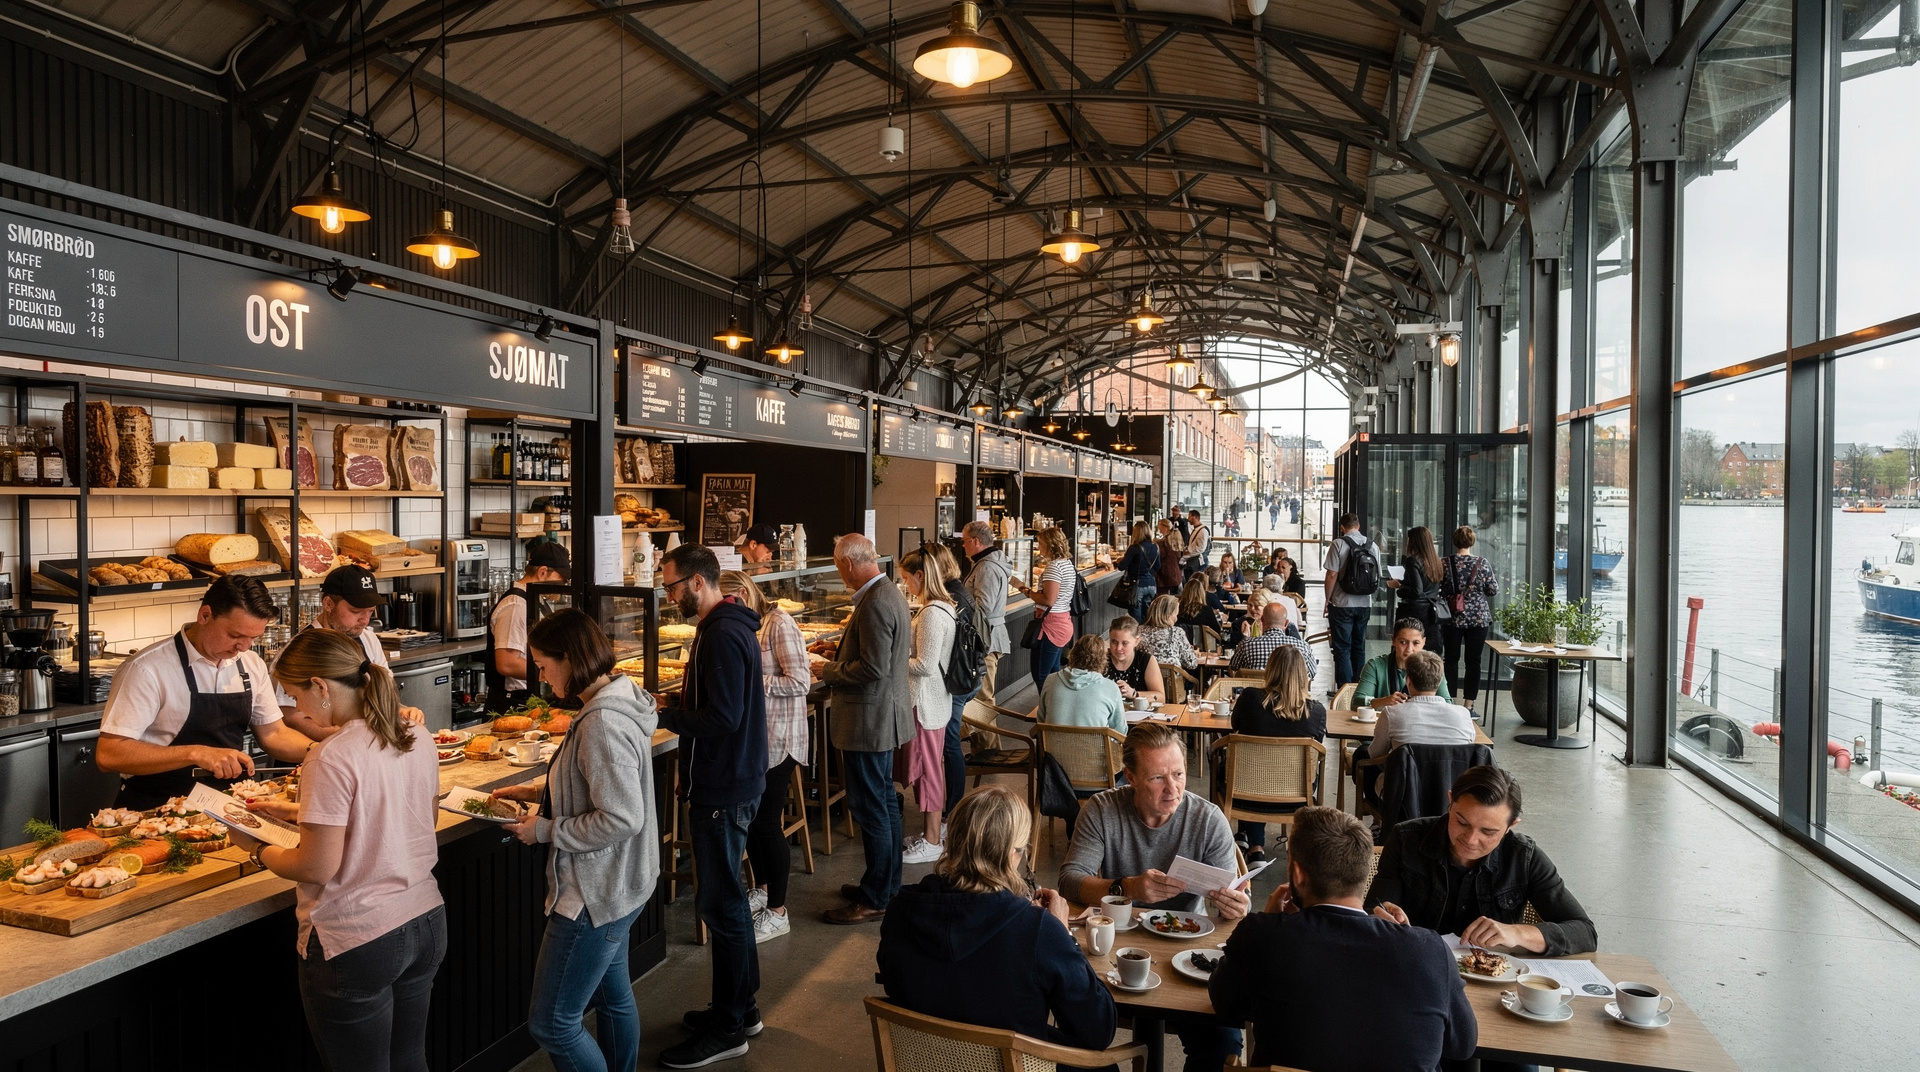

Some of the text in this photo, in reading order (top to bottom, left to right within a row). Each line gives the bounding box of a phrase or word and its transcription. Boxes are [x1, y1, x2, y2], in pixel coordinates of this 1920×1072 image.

[7, 250, 42, 268] KAFFE
[7, 266, 35, 283] KAFE
[47, 319, 76, 335] MENU
[245, 294, 310, 351] OST
[489, 341, 569, 390] SJØMAT
[756, 396, 786, 426] KAFFE
